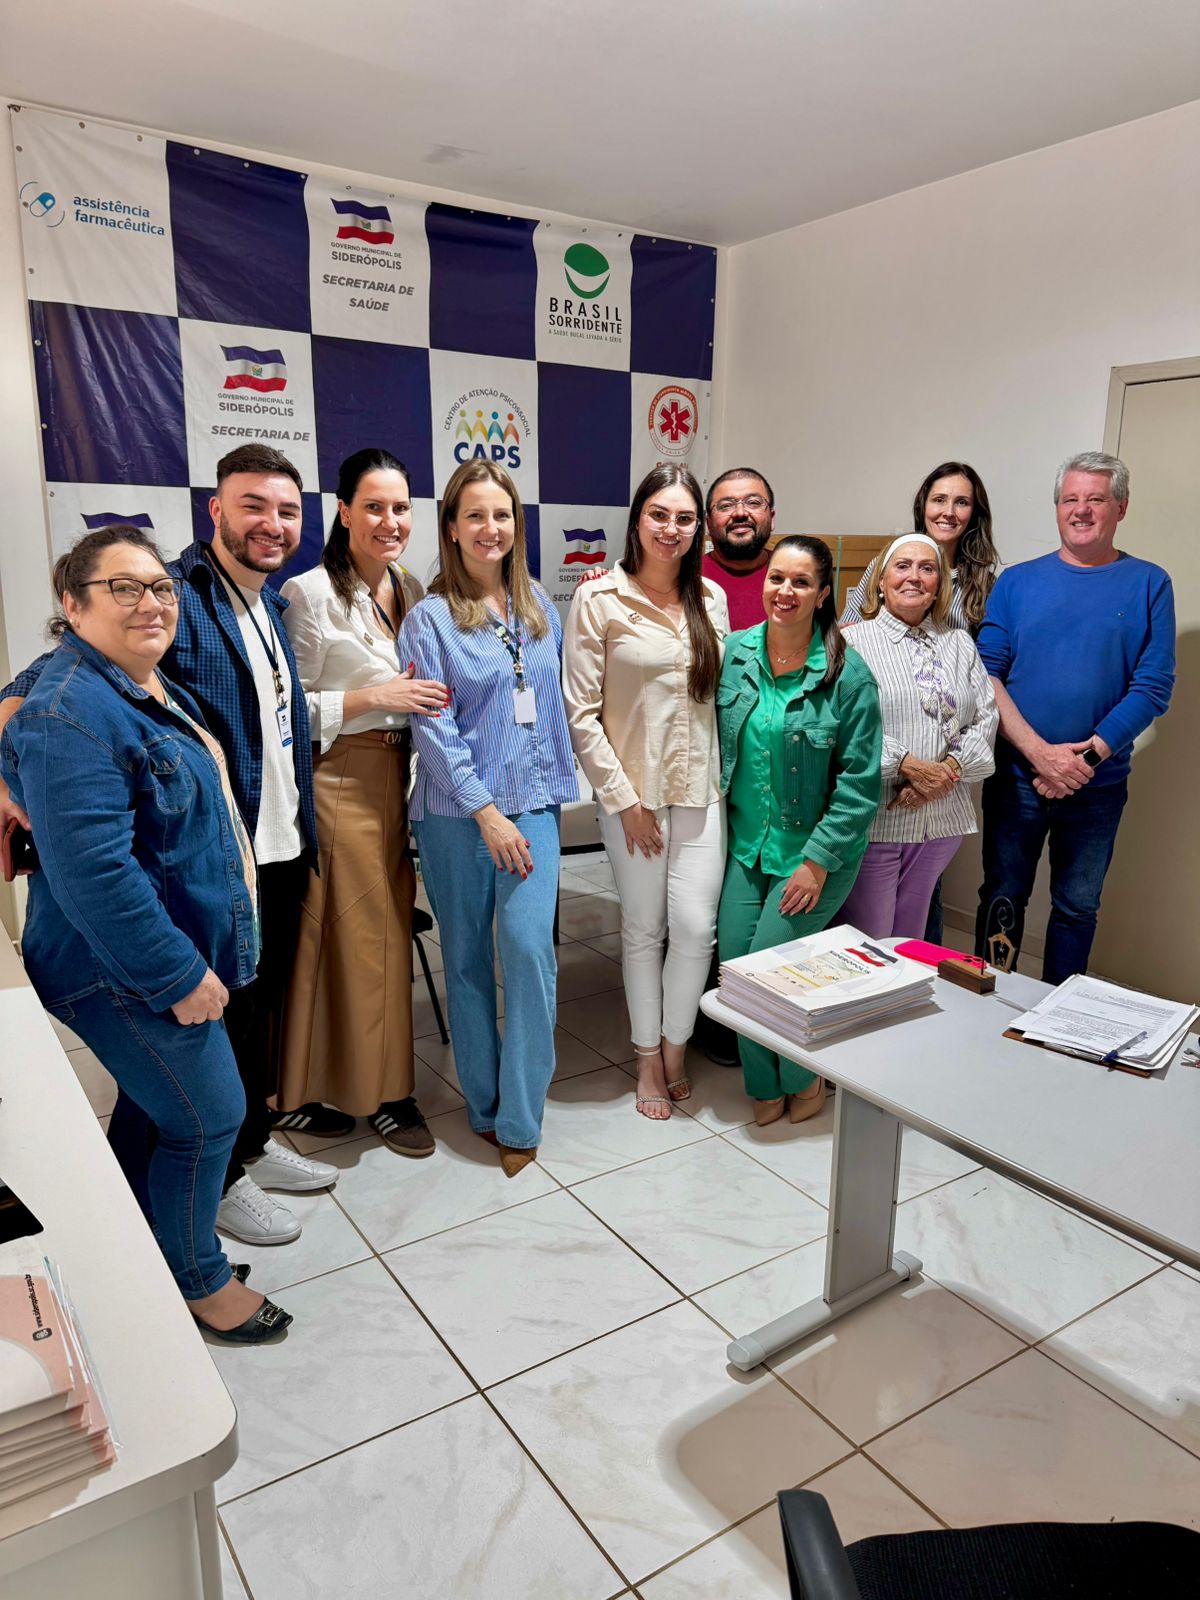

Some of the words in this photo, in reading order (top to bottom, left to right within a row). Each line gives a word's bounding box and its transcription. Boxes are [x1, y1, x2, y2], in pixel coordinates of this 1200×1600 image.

[73, 196, 150, 218] assistência
[75, 209, 165, 235] farmacêutica
[330, 242, 360, 252] GOVERNO
[362, 247, 392, 257] MUNICIPAL
[331, 251, 402, 270] SIDERÓPOLIS
[322, 274, 396, 293] SECRETARIA
[398, 286, 414, 295] DE
[349, 298, 390, 312] SAÚDE
[550, 297, 622, 321] BRASIL
[549, 314, 622, 334] SORRIDENTE
[218, 393, 249, 401] GOVERNO
[250, 396, 284, 404] MUNICIPAL
[219, 402, 294, 417] SIDERÓPOLIS
[444, 402, 460, 430] CENTRO
[459, 394, 468, 404] DE
[468, 388, 498, 398] ATENÇÃO
[500, 392, 531, 437] PSICOSSOCIAL
[211, 425, 290, 440] SECRETARIA
[293, 432, 310, 442] DE
[454, 442, 521, 469] CAPS
